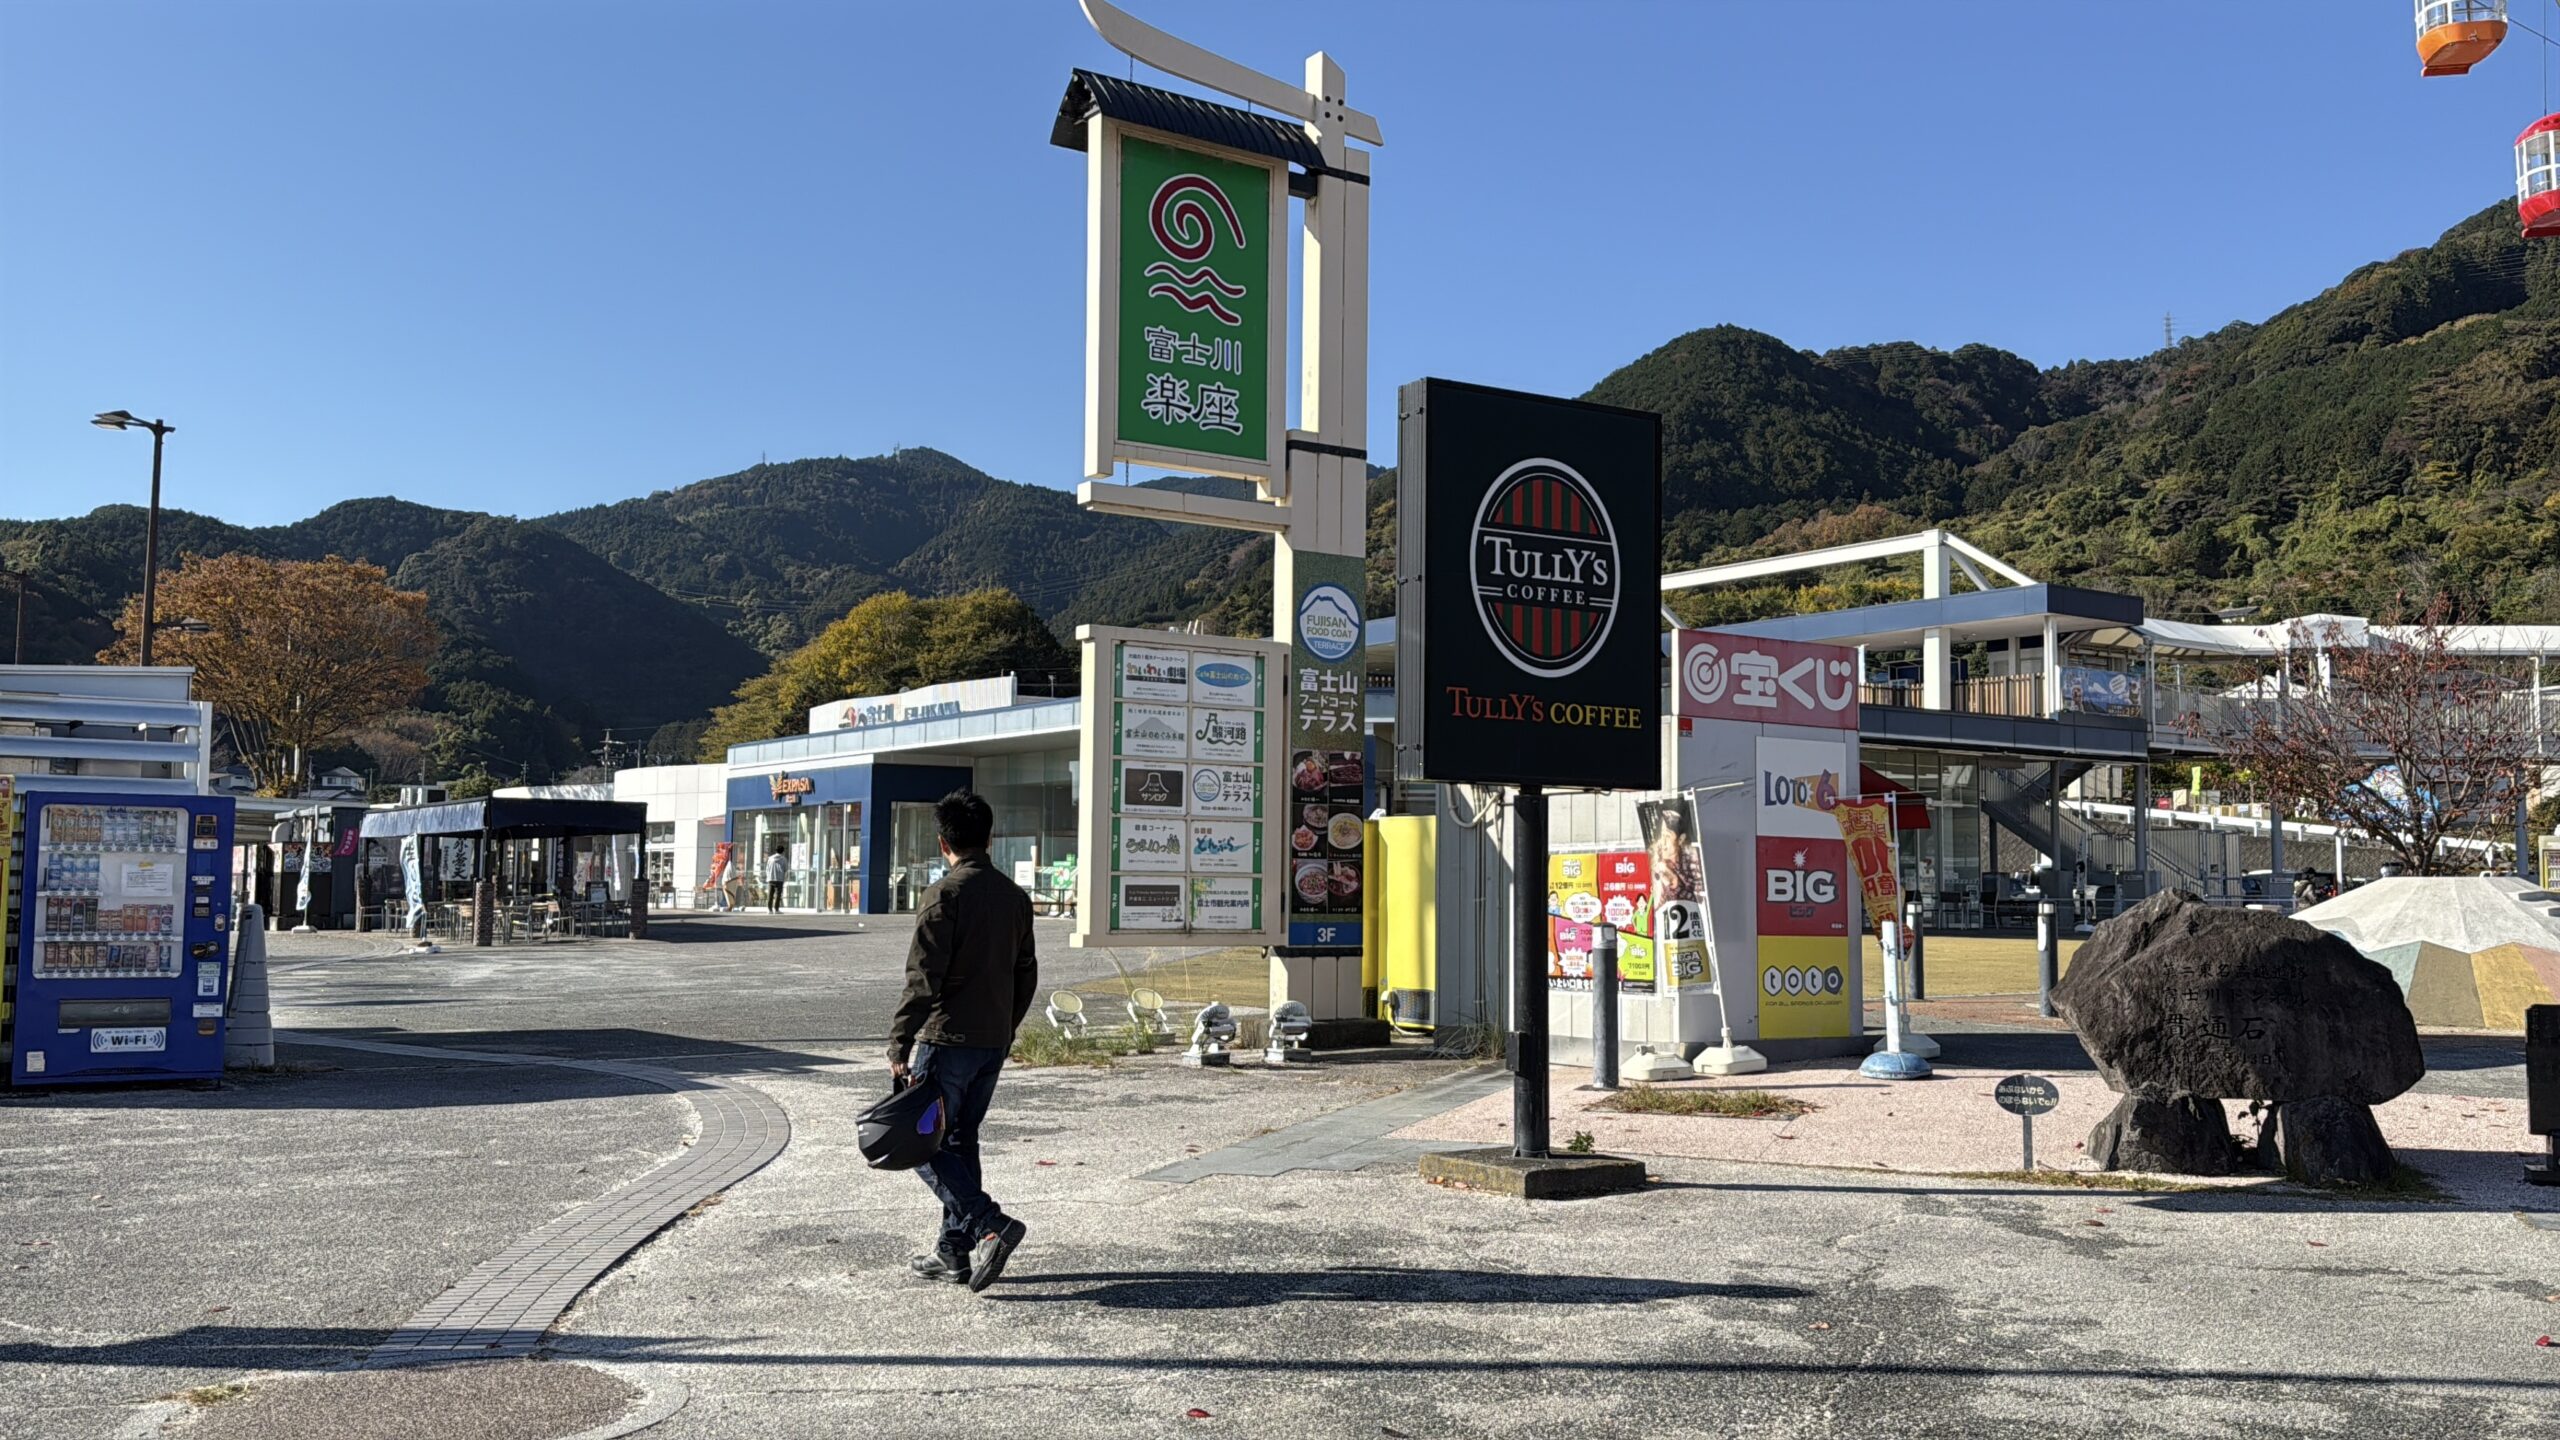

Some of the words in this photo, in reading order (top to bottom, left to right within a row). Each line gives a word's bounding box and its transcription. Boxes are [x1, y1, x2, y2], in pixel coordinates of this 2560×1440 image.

[1144, 326, 1242, 375] 富士川
[1141, 374, 1243, 435] 楽座
[1483, 536, 1608, 586] TULLY'S
[1507, 584, 1586, 605] COFFEE
[1306, 615, 1347, 629] FUJISAN
[1306, 627, 1330, 637] FOOD
[1331, 628, 1353, 638] COAT
[1313, 640, 1346, 651] TERRACE
[1126, 663, 1186, 678] わいわい劇場
[1299, 668, 1359, 695] 富士山
[1730, 650, 1853, 711] 宝くじ
[1299, 694, 1359, 710] フードコート
[1446, 686, 1544, 724] TULLY'S
[1550, 702, 1642, 729] COFFEE
[1299, 709, 1358, 733] テラス
[1212, 725, 1247, 740] 駿河路
[1222, 771, 1252, 783] 富士山
[1222, 790, 1252, 802] テラス
[1763, 770, 1807, 806] LOTO
[1816, 768, 1836, 810] 6
[1615, 862, 1635, 874] BIG
[1766, 869, 1836, 904] BIG
[1317, 928, 1336, 942] 3F
[1672, 962, 1702, 976] BIG
[1764, 966, 1842, 994] toto
[2163, 1013, 2266, 1041] 貫通石
[111, 1034, 147, 1046] Wi-Fi
[1998, 1084, 2045, 1095] あぶないから
